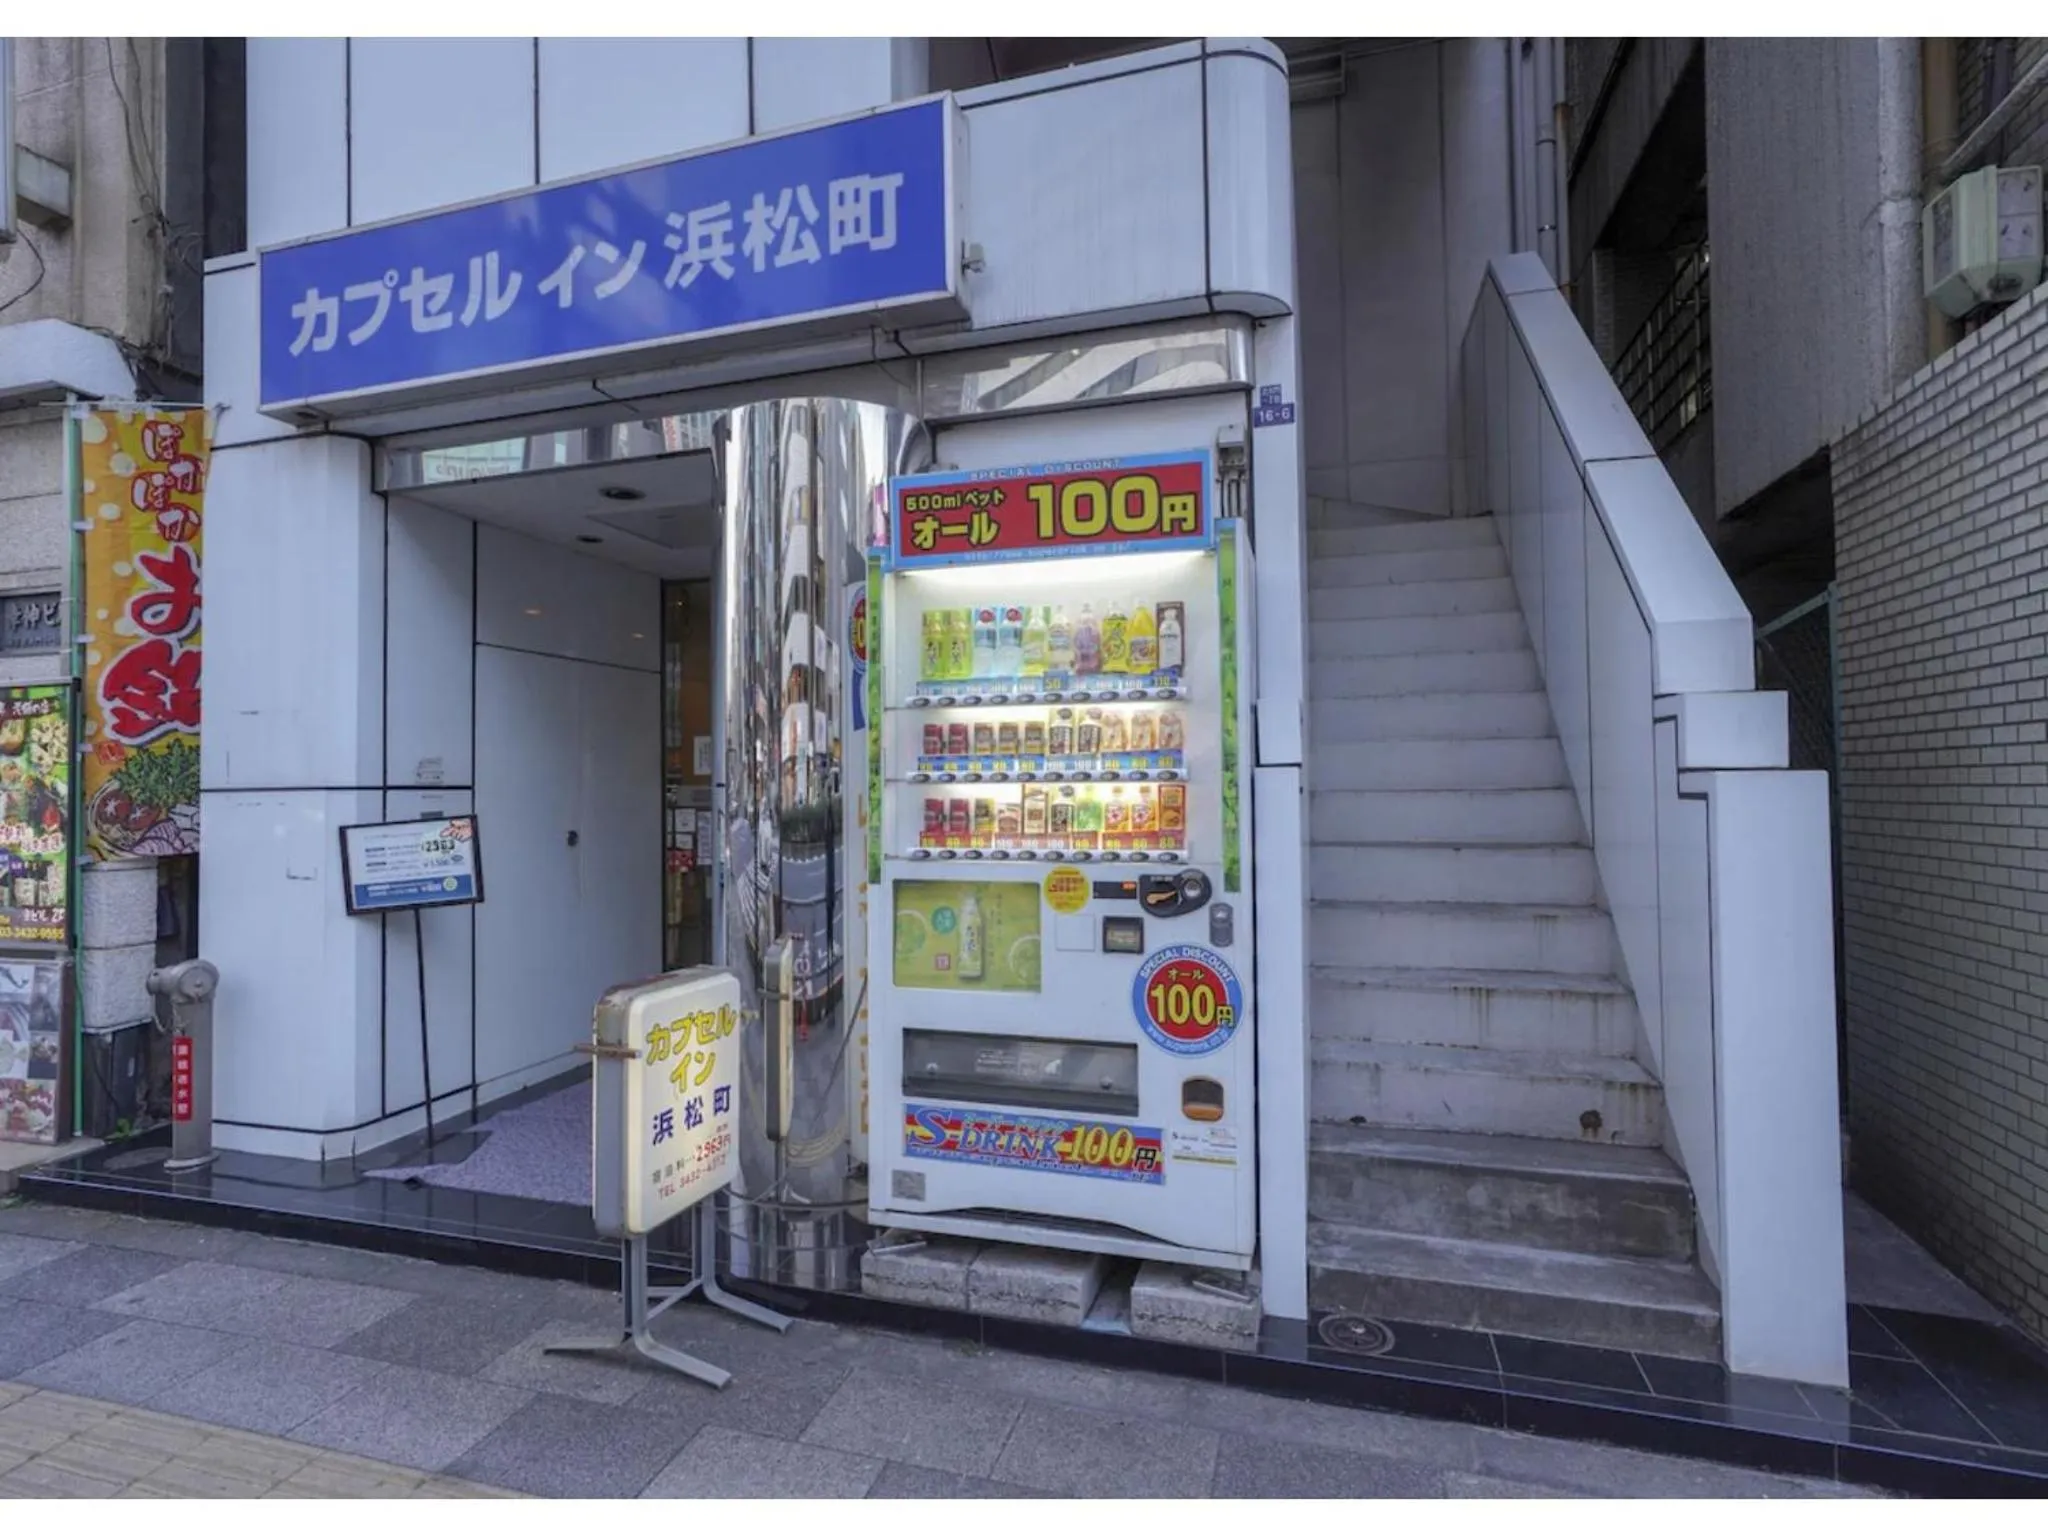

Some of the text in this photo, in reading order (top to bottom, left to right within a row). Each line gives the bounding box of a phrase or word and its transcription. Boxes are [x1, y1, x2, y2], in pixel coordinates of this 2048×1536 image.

[1259, 408, 1291, 423] 16-6
[1027, 475, 1198, 539] 100円
[911, 510, 1001, 551] オール
[1167, 967, 1205, 981] オール
[1150, 983, 1236, 1029] 100円
[645, 1003, 737, 1066] カプセル
[670, 1050, 717, 1094] イン
[651, 1085, 732, 1146] 浜松町
[908, 1106, 1062, 1160] S-DRINK
[1062, 1124, 1160, 1173] 100円
[658, 1181, 677, 1201] TEL
